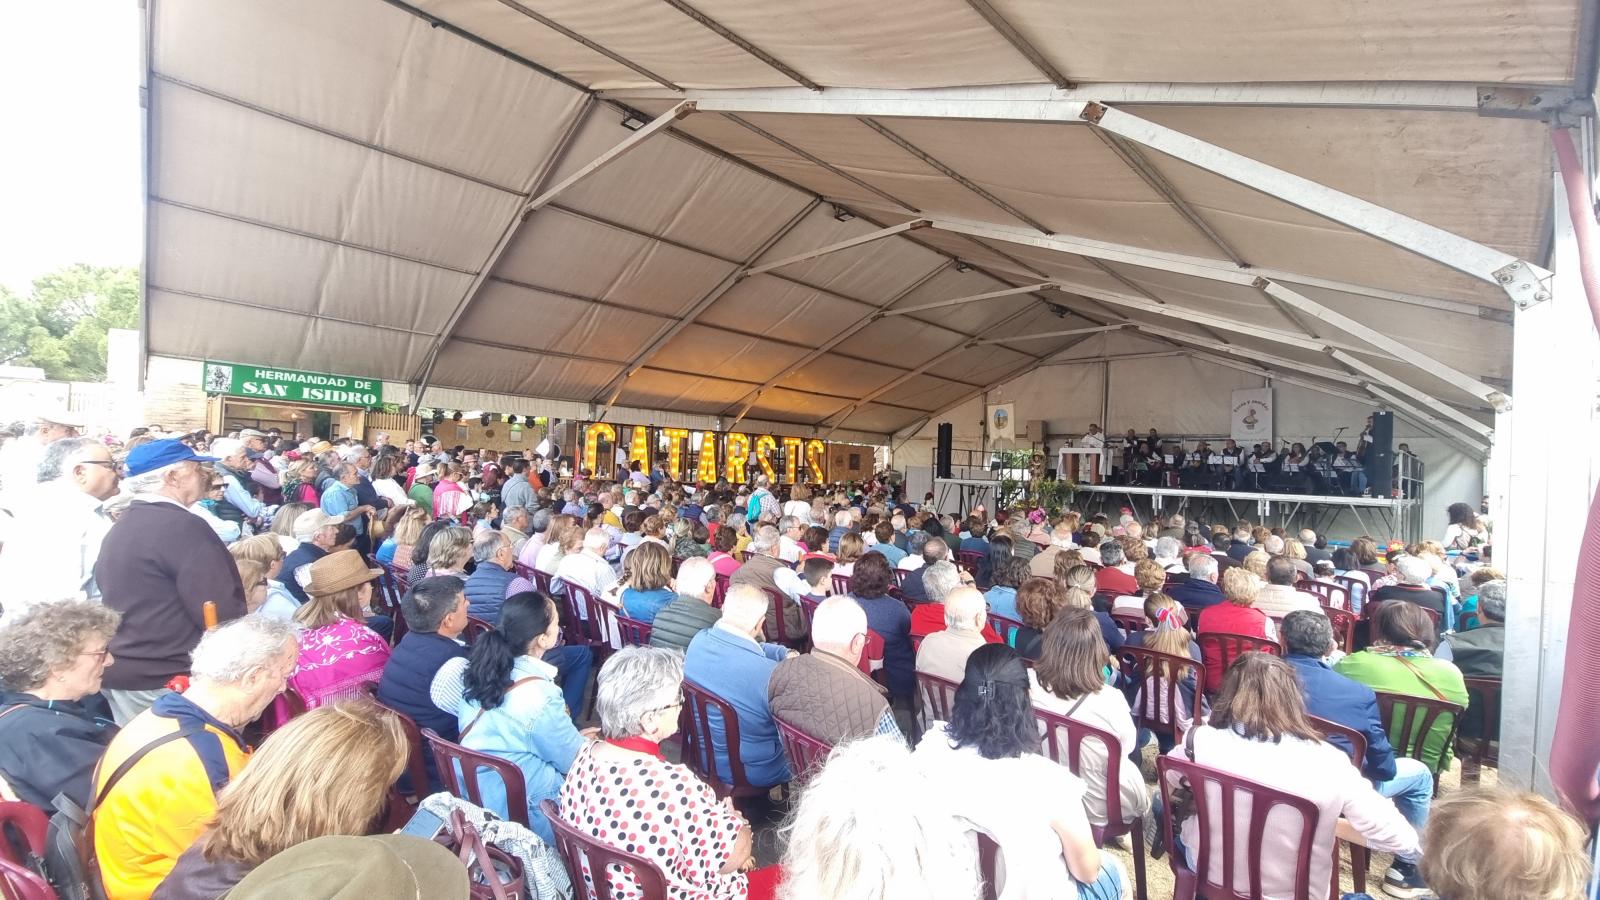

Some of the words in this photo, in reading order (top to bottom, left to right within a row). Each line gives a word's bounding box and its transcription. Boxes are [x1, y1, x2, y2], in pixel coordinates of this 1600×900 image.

[255, 370, 347, 387] HERMANDAD
[354, 380, 372, 390] DE
[242, 382, 289, 397] SAN
[302, 387, 377, 405] ISIDRO
